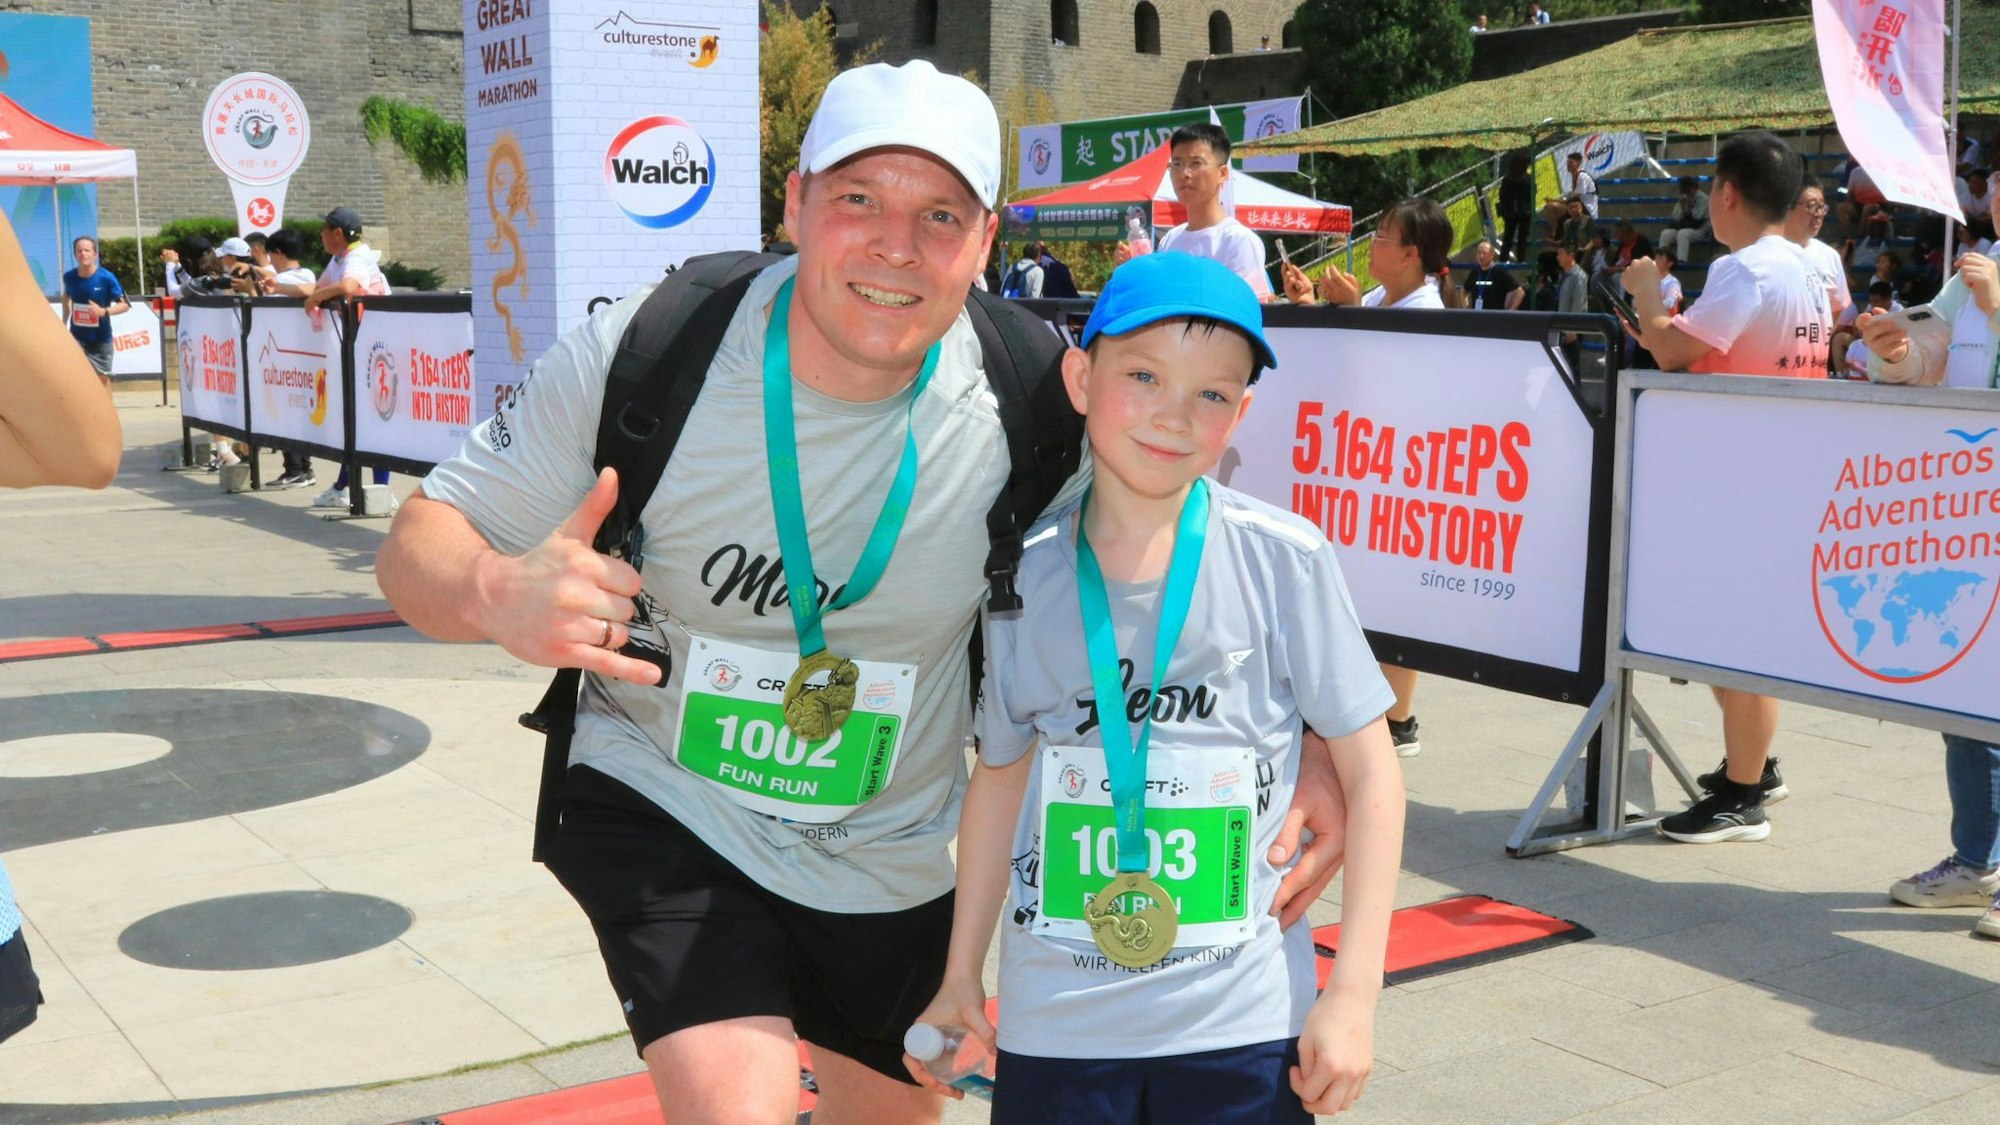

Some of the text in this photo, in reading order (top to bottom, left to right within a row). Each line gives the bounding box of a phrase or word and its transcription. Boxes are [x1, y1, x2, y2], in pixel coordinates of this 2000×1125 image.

[480, 35, 533, 74] WALL
[603, 30, 696, 47] culturestone
[478, 78, 537, 108] MARATHON
[1076, 135, 1096, 166] 起
[612, 159, 709, 184] Walch
[263, 363, 314, 389] culturestone
[410, 348, 440, 387] 5.164
[441, 350, 471, 391] STEPS
[412, 391, 471, 426] INTO HISTORY
[1292, 401, 1531, 502] 5.164 STEPS
[1834, 446, 1994, 491] Albatros
[1292, 483, 1524, 574] INTO HISTORY
[1818, 487, 2000, 533] Adventure
[1420, 570, 1516, 601] since 1999
[716, 715, 842, 768] 1002
[865, 725, 892, 797] Start Wave 3
[718, 763, 819, 797] FUN RUN
[1072, 825, 1197, 880] 1003
[1230, 820, 1243, 907] Start Wave 3
[1073, 954, 1108, 971] WIR
[1191, 945, 1245, 962] KIND
